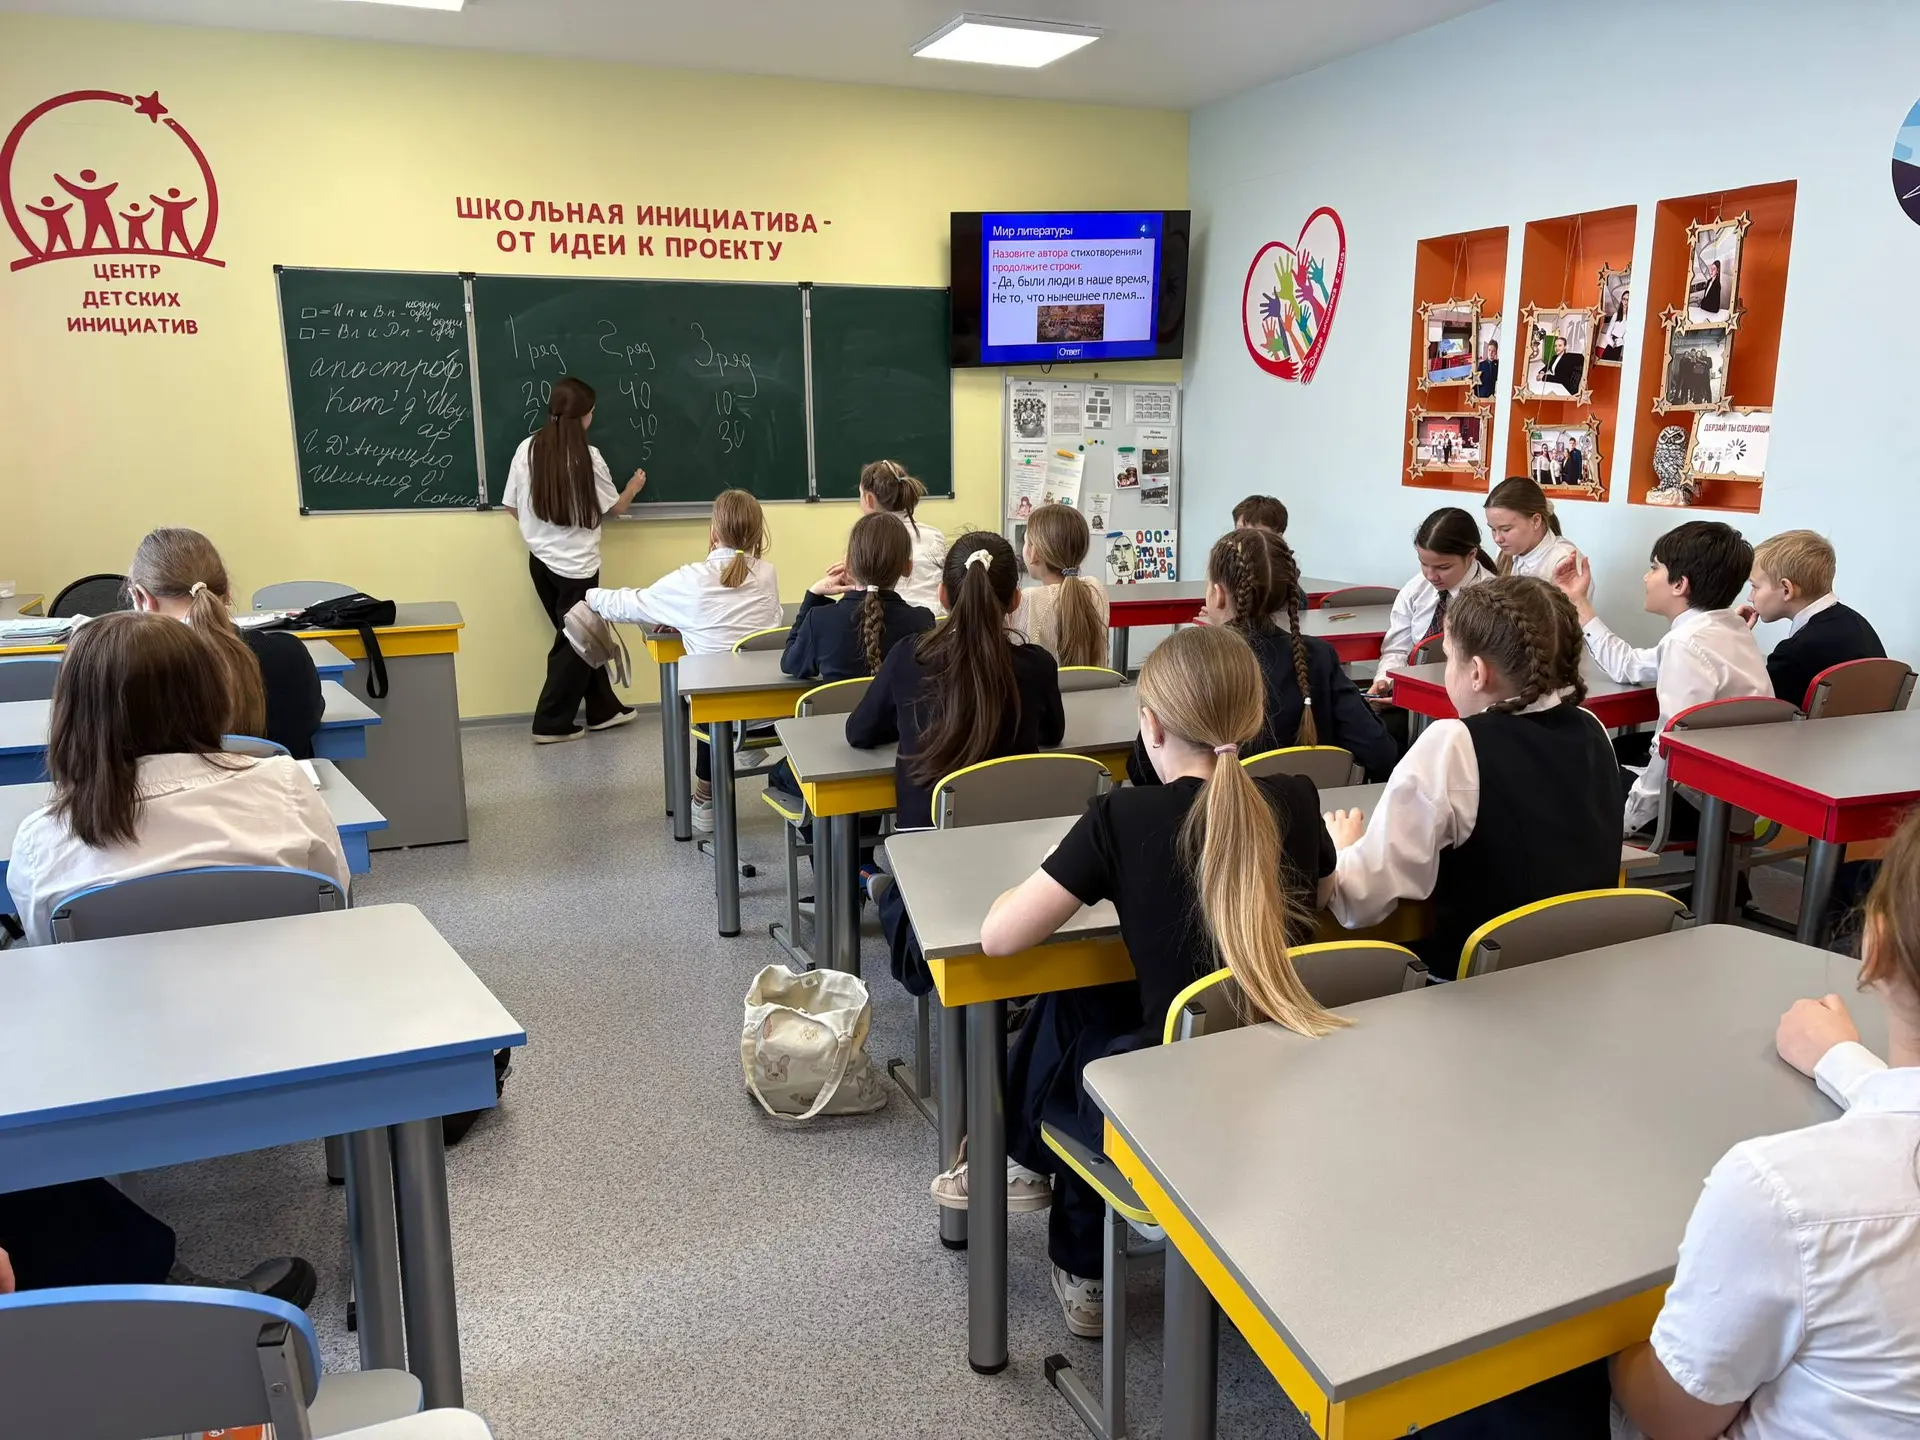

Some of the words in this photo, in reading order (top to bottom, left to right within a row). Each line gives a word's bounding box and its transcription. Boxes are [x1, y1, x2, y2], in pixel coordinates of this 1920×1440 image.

[456, 196, 624, 225] ШКОЛЬНАЯ
[992, 225, 1016, 239] Мир
[1016, 227, 1074, 239] литературы
[496, 230, 536, 253] ОТ
[550, 232, 626, 260] ИДЕИ
[638, 235, 655, 257] К
[665, 237, 783, 261] ПРОЕКТУ
[992, 249, 1036, 259] Назовите
[1037, 249, 1069, 259] автора
[93, 263, 162, 282] ЦЕНТР
[992, 263, 1048, 274] продолжите
[997, 275, 1015, 290] Да,
[1017, 275, 1045, 287] были
[1047, 276, 1076, 288] люди
[1077, 277, 1084, 286] в
[1086, 275, 1114, 285] наше
[1115, 275, 1150, 287] время,
[82, 289, 181, 309] ДЕТСКИХ
[992, 292, 1007, 304] Не
[1009, 294, 1024, 305] то,
[1026, 293, 1045, 303] что
[1046, 292, 1101, 303] нынешнее
[66, 316, 199, 337] ИНИЦИАТИВ
[597, 319, 623, 358] 2
[626, 341, 656, 371] ряд
[1058, 347, 1081, 357] Ответ
[690, 321, 714, 368] 3
[715, 351, 758, 399] ряд
[520, 380, 552, 407] 20
[618, 377, 652, 410] 40
[714, 389, 733, 417] 10
[628, 414, 659, 438] 40
[1728, 424, 1737, 432] ТЫ
[1135, 544, 1154, 558] ЭТО
